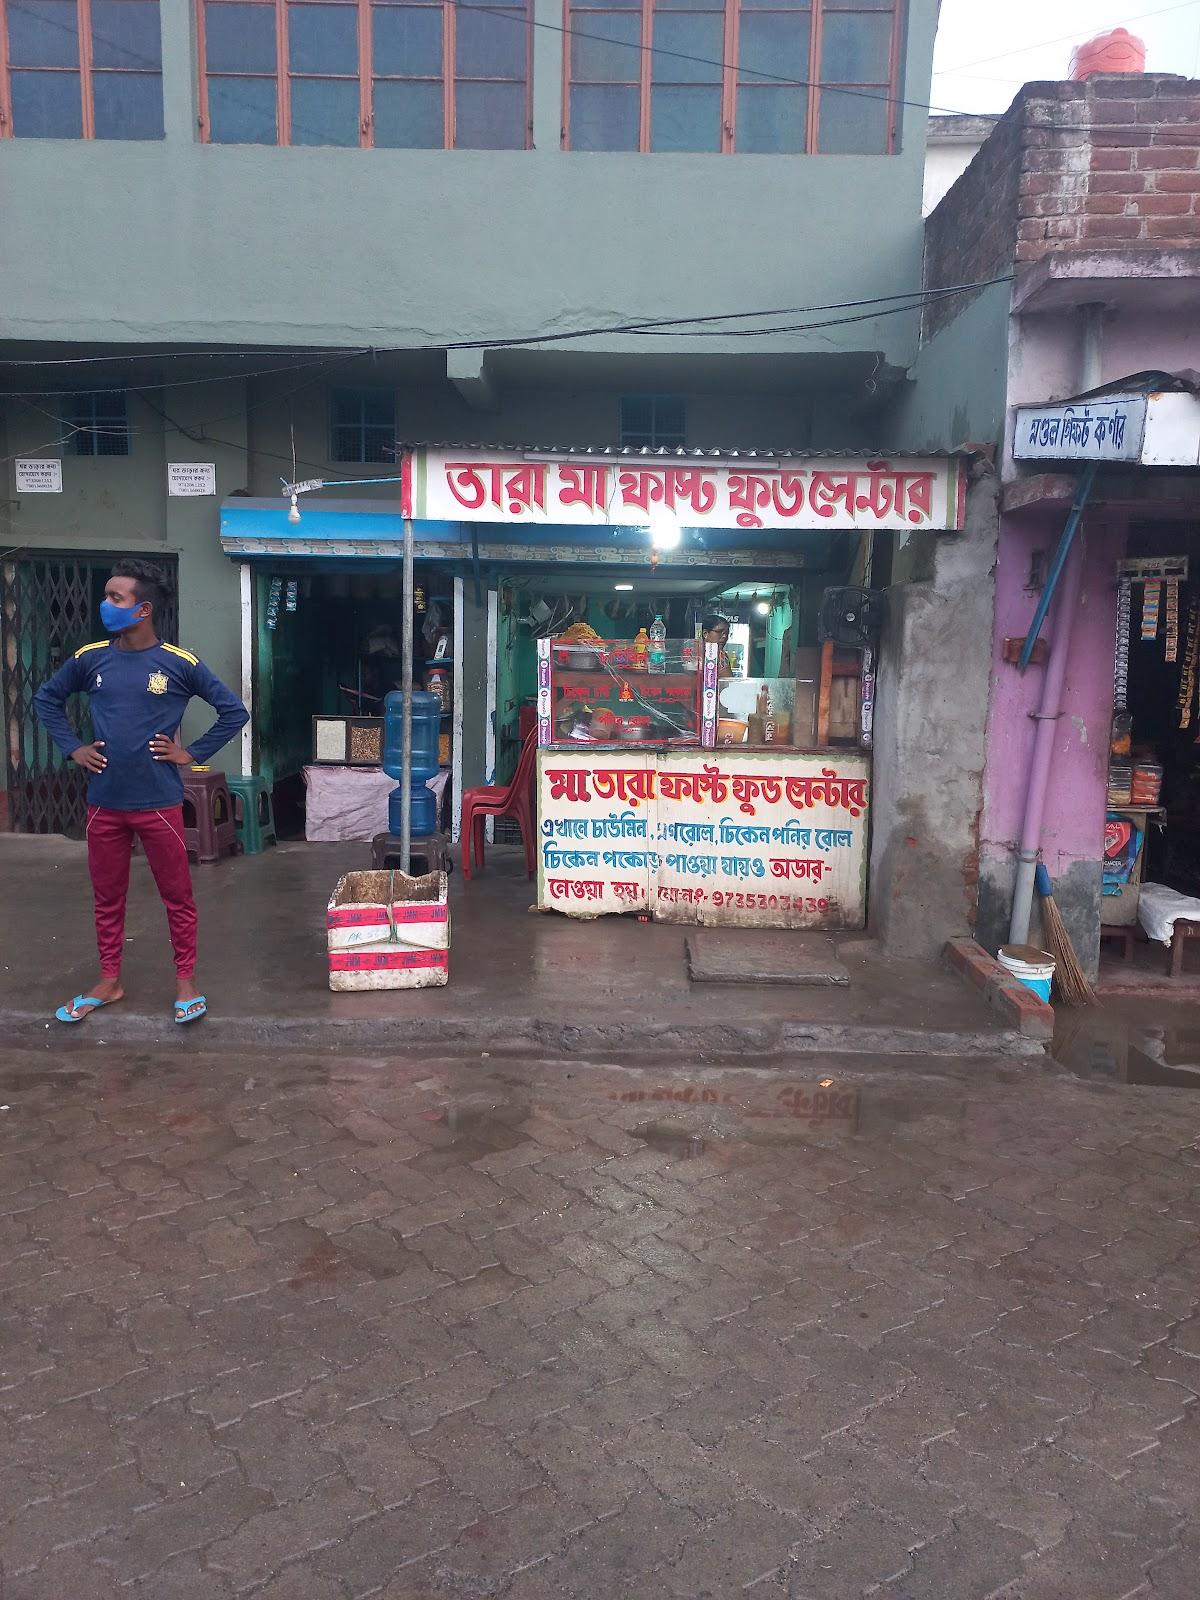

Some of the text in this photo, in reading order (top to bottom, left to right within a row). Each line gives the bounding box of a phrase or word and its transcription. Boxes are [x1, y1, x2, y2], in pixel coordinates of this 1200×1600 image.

[445, 463, 548, 516] তারা
[558, 464, 610, 516] মা
[727, 468, 807, 527] ফুড
[809, 460, 938, 524] সেন্টার
[544, 769, 592, 803] মা
[592, 769, 657, 808] তারা
[658, 764, 730, 803] ফাস্ট
[732, 774, 783, 816] ফুড
[541, 818, 589, 840] এখানে
[719, 816, 771, 846] চিকেন
[772, 818, 812, 850] পনির
[815, 829, 853, 852] রোল
[543, 840, 600, 869] চিকেন
[548, 878, 604, 901] নেওয়া
